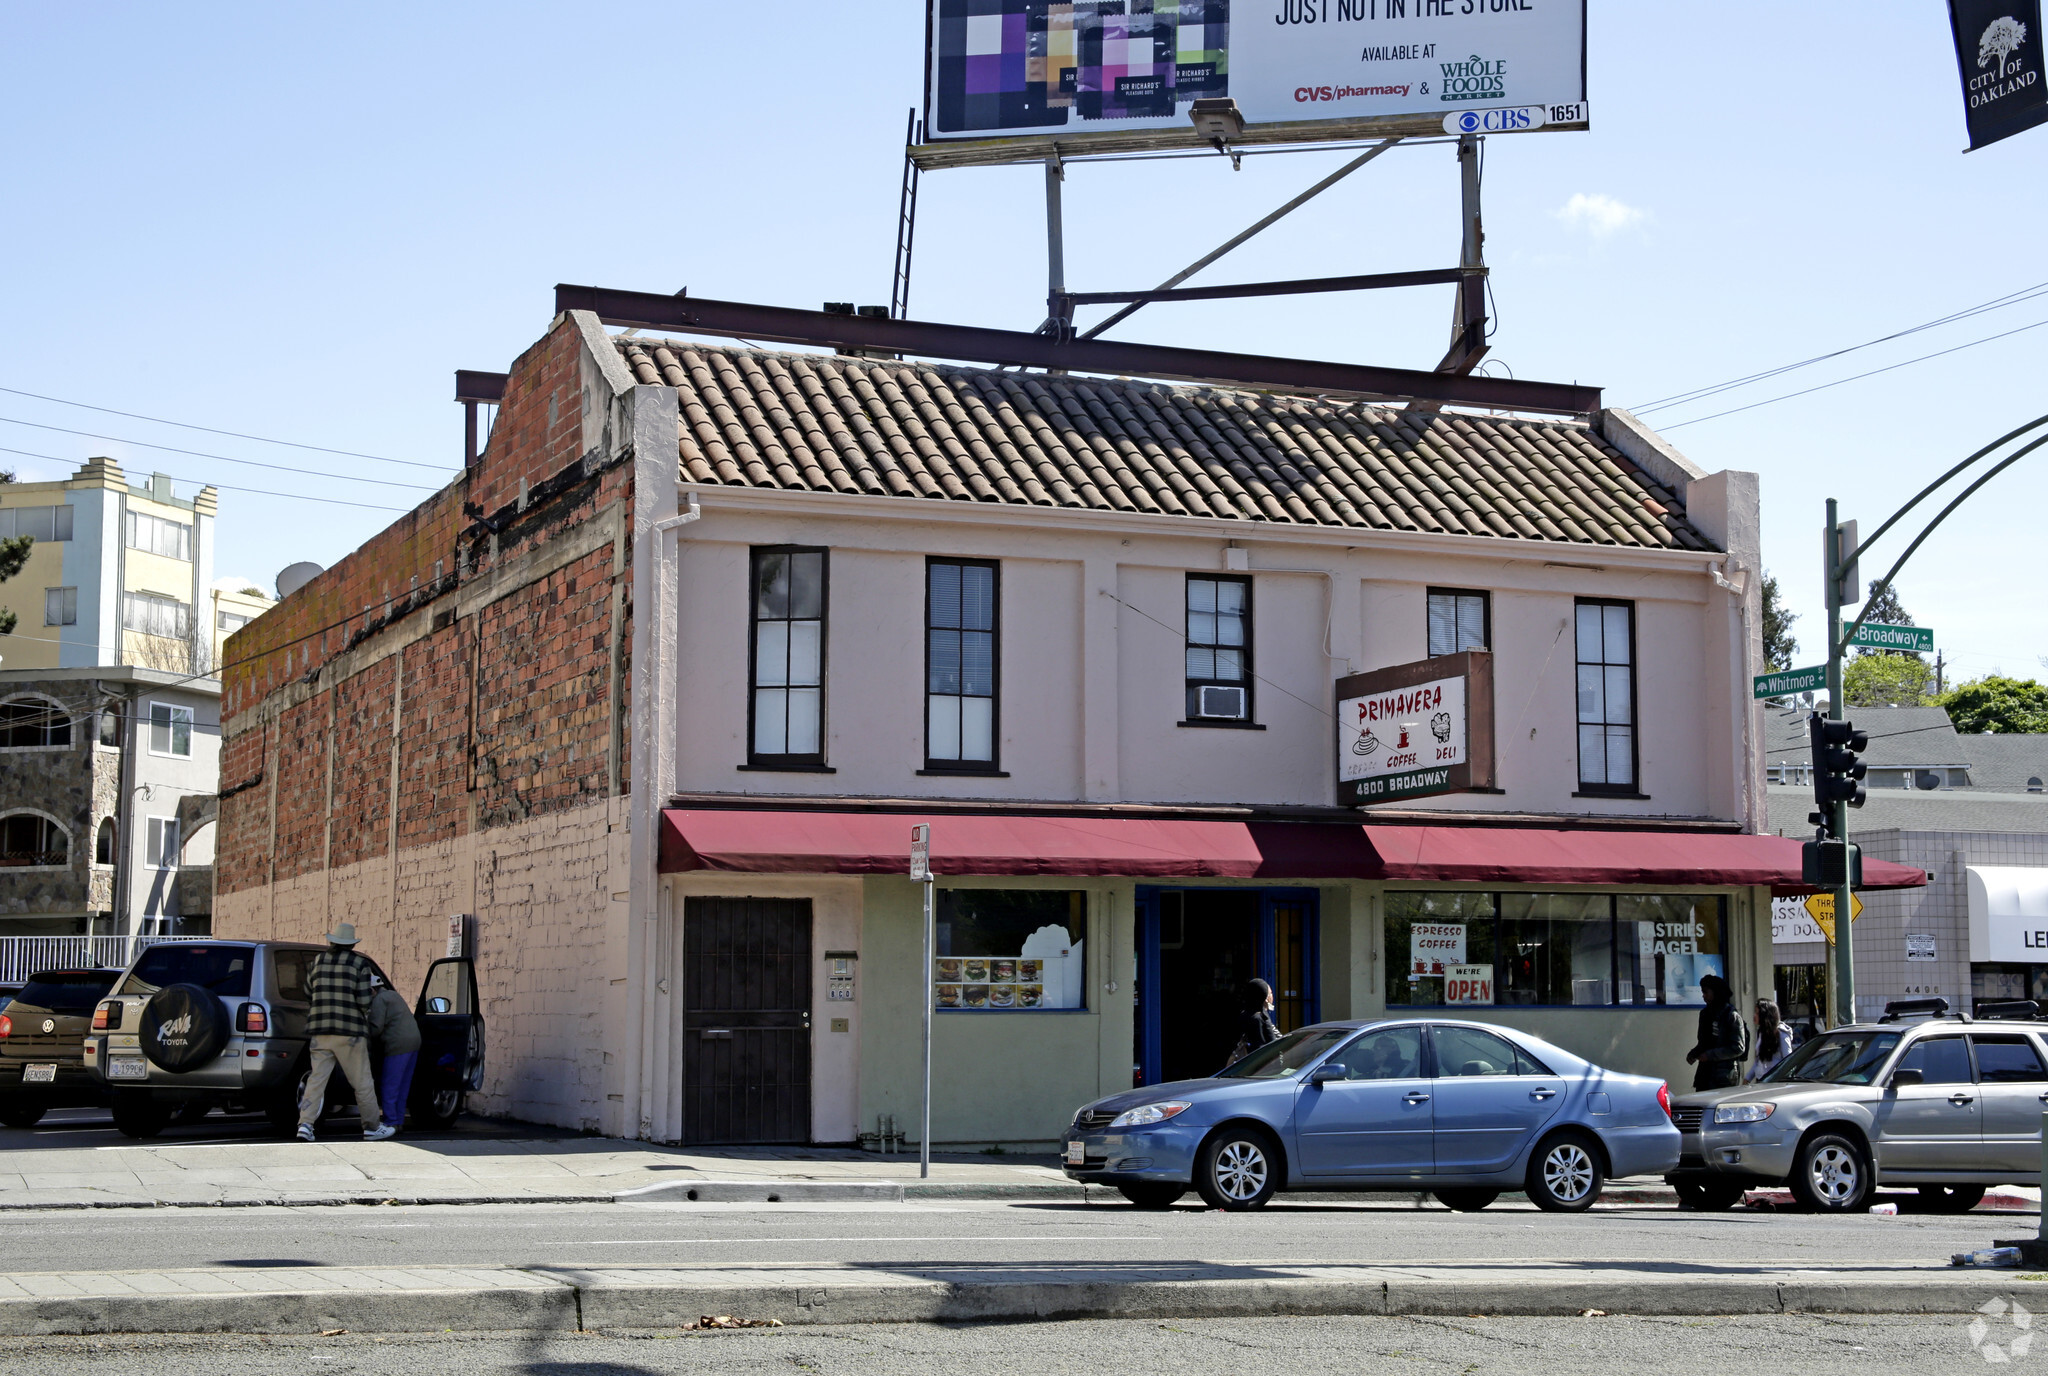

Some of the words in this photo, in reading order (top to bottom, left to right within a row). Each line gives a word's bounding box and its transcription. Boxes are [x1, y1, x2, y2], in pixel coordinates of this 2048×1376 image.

[1361, 44, 1419, 62] AVAILABLE
[1422, 44, 1436, 58] AT
[1440, 57, 1507, 78] WHOLE
[1969, 69, 1997, 91] CITY
[2007, 58, 2022, 75] OF
[1120, 83, 1129, 91] SIR
[1294, 85, 1410, 103] CVS/pharmacy
[1420, 82, 1430, 95] &
[1443, 76, 1503, 93] FOODS
[1970, 70, 2037, 109] OAKLAND
[1445, 92, 1502, 100] MARKET
[1483, 108, 1531, 131] CBS
[1550, 104, 1581, 122] 1651
[1859, 626, 1919, 649] Broadway
[1918, 643, 1932, 651] 4800
[1768, 674, 1815, 693] Whitmore
[1818, 666, 1824, 674] ST
[1358, 686, 1442, 725] PRIMAVERA
[1386, 753, 1417, 769] COFFEE
[1436, 746, 1457, 761] DELI
[1356, 780, 1384, 796] 4800
[1389, 770, 1449, 792] BROADWAY
[1816, 899, 1835, 908] THRO
[1820, 912, 1835, 921] STR
[1411, 925, 1462, 936] ESPRESSO
[2024, 930, 2048, 948] LE
[1419, 939, 1457, 949] COFFEE
[1447, 979, 1491, 1001] OPEN
[157, 1012, 192, 1042] RAV4
[162, 1038, 188, 1046] TOYOTA
